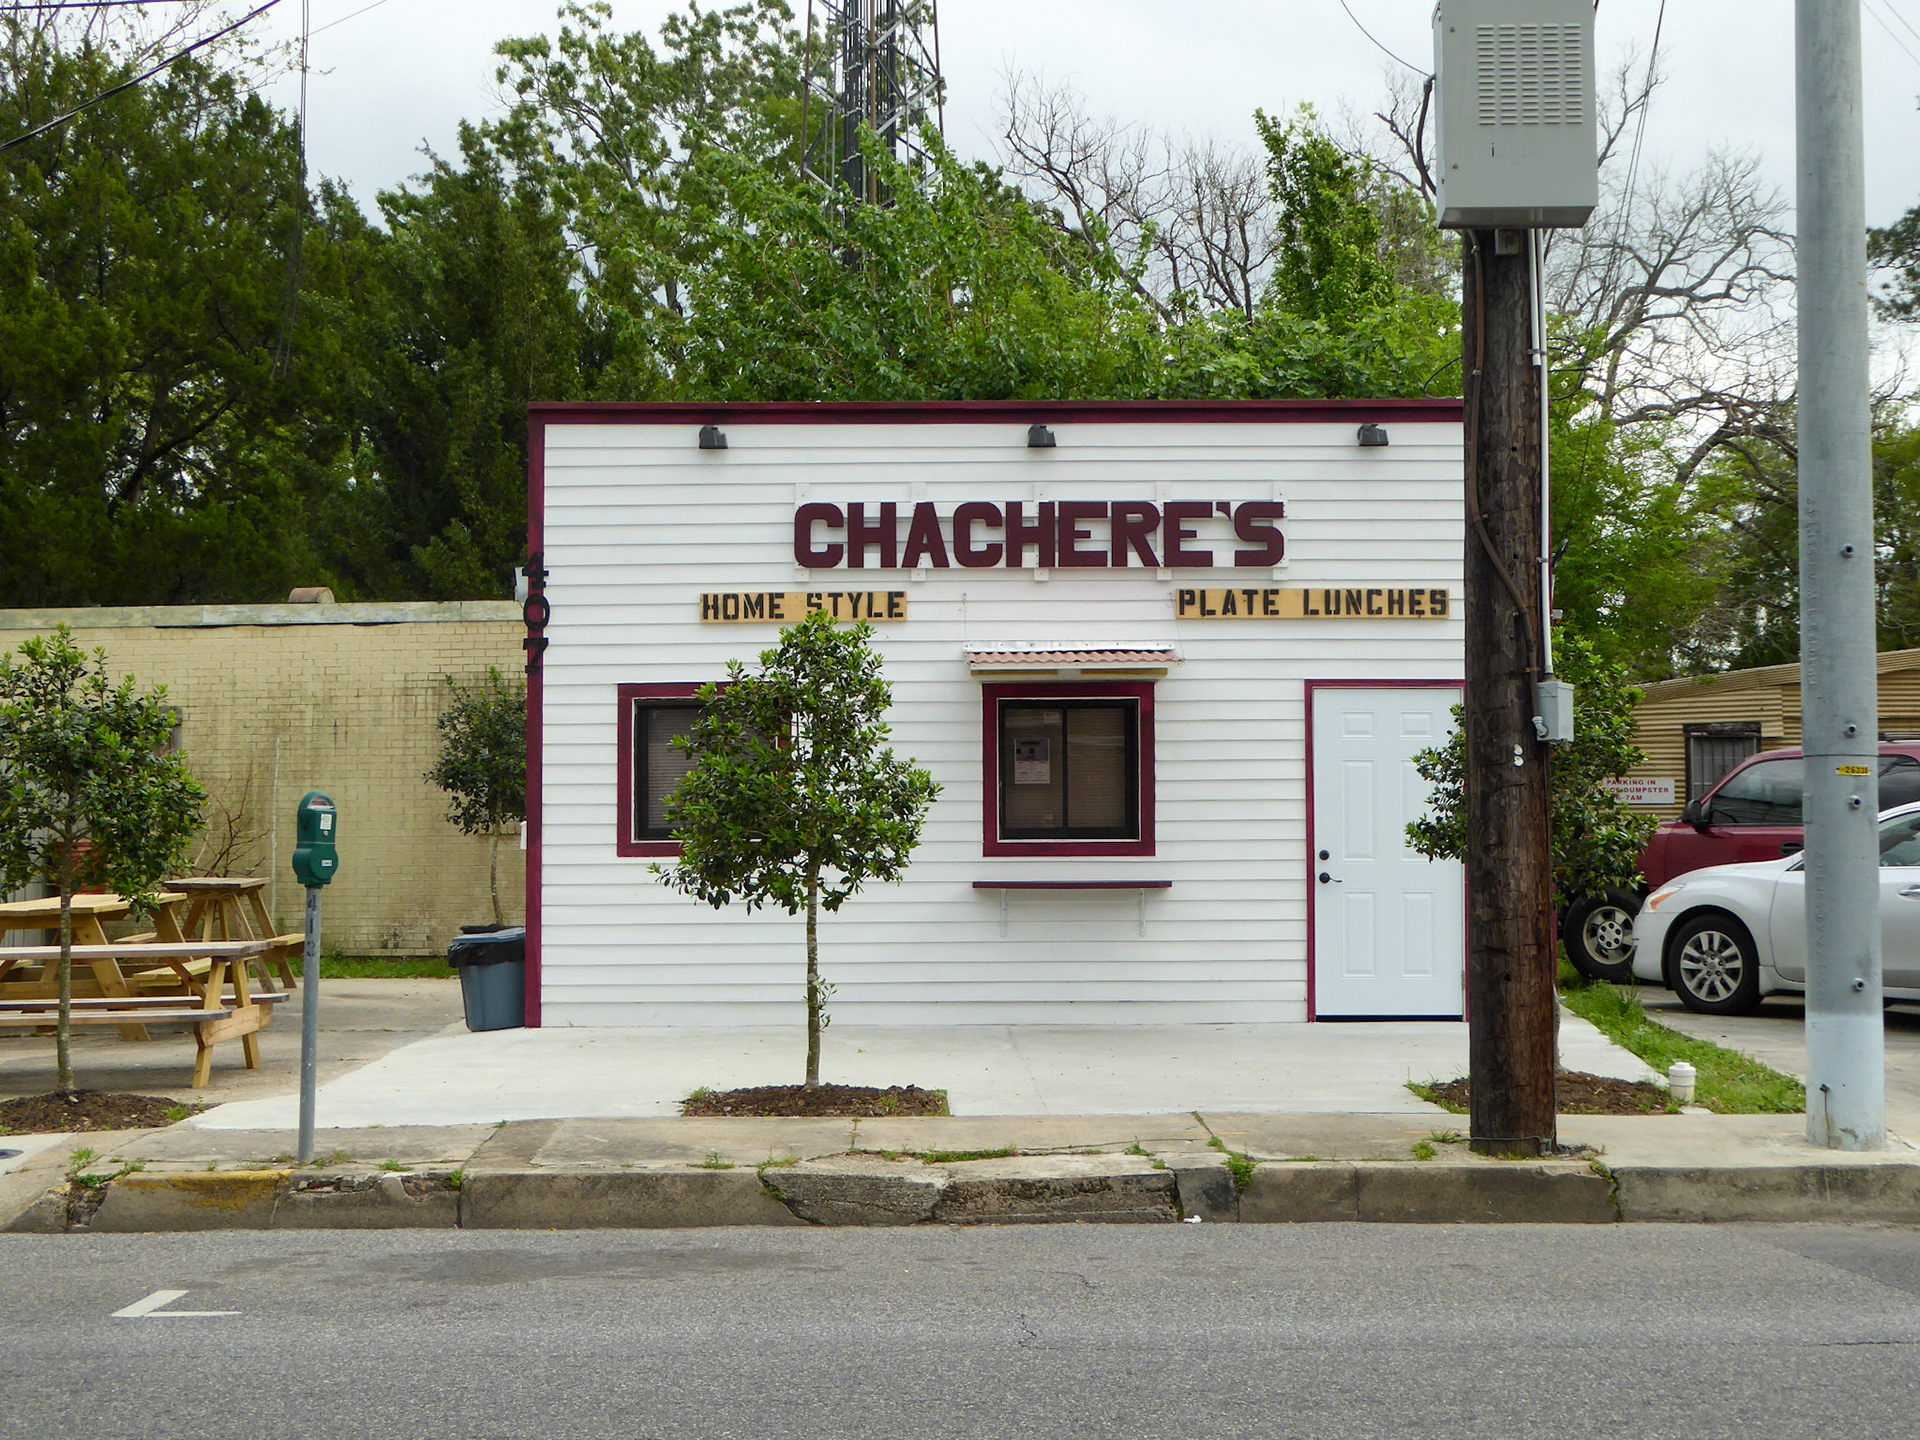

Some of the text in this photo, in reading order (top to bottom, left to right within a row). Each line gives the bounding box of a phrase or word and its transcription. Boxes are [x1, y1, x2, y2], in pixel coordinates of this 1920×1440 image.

[794, 501, 1285, 568] CHACHERE'S
[522, 552, 550, 674] 407
[702, 591, 905, 620] HOME STYLE
[1179, 589, 1447, 616] PLATE LUNCHES
